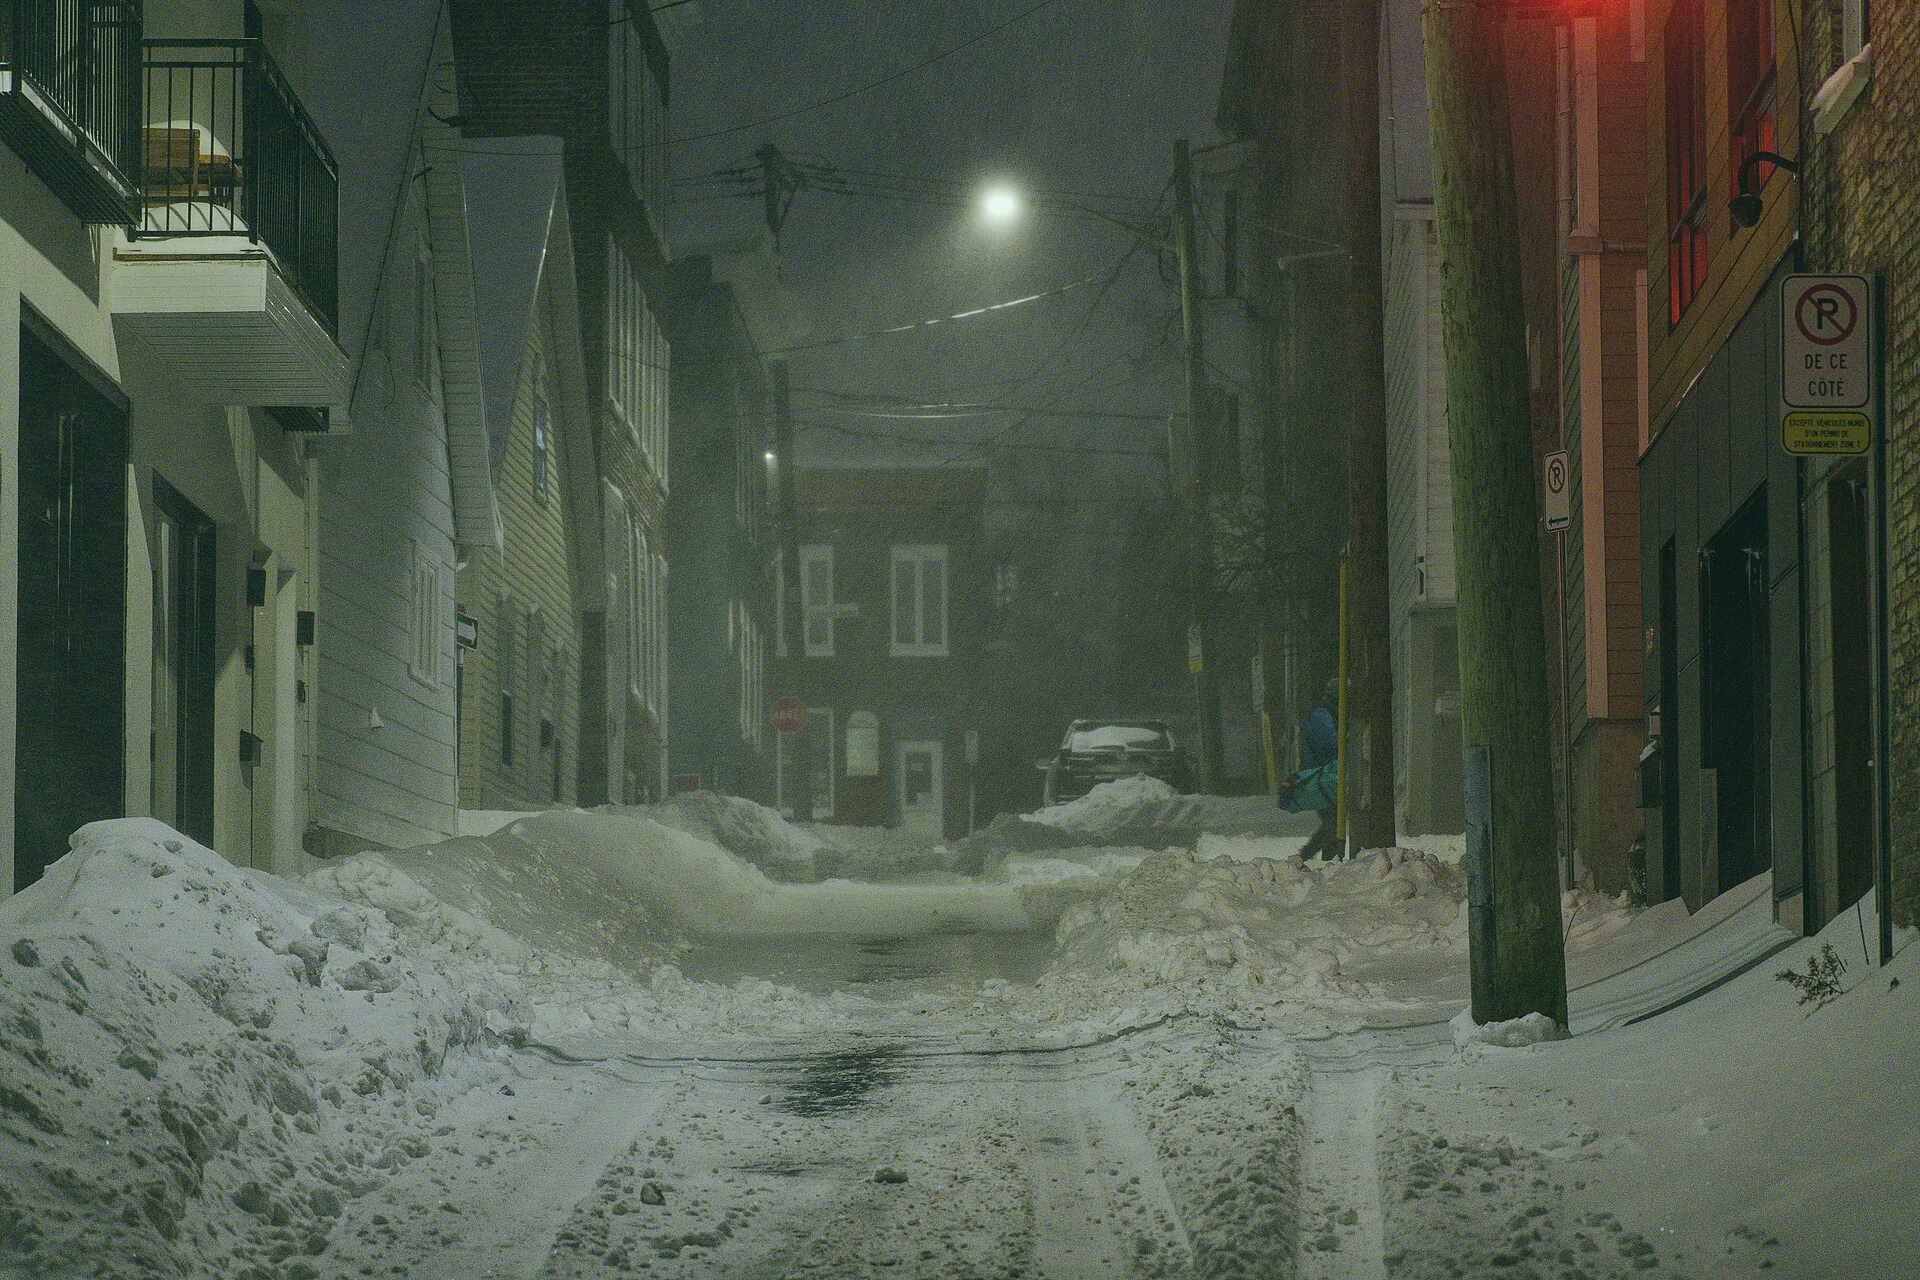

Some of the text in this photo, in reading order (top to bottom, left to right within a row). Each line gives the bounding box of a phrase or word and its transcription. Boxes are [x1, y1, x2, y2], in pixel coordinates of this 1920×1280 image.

[1805, 354, 1847, 370] DE CE
[1808, 377, 1845, 397] CÔTÉ
[1840, 440, 1854, 448] ZONE
